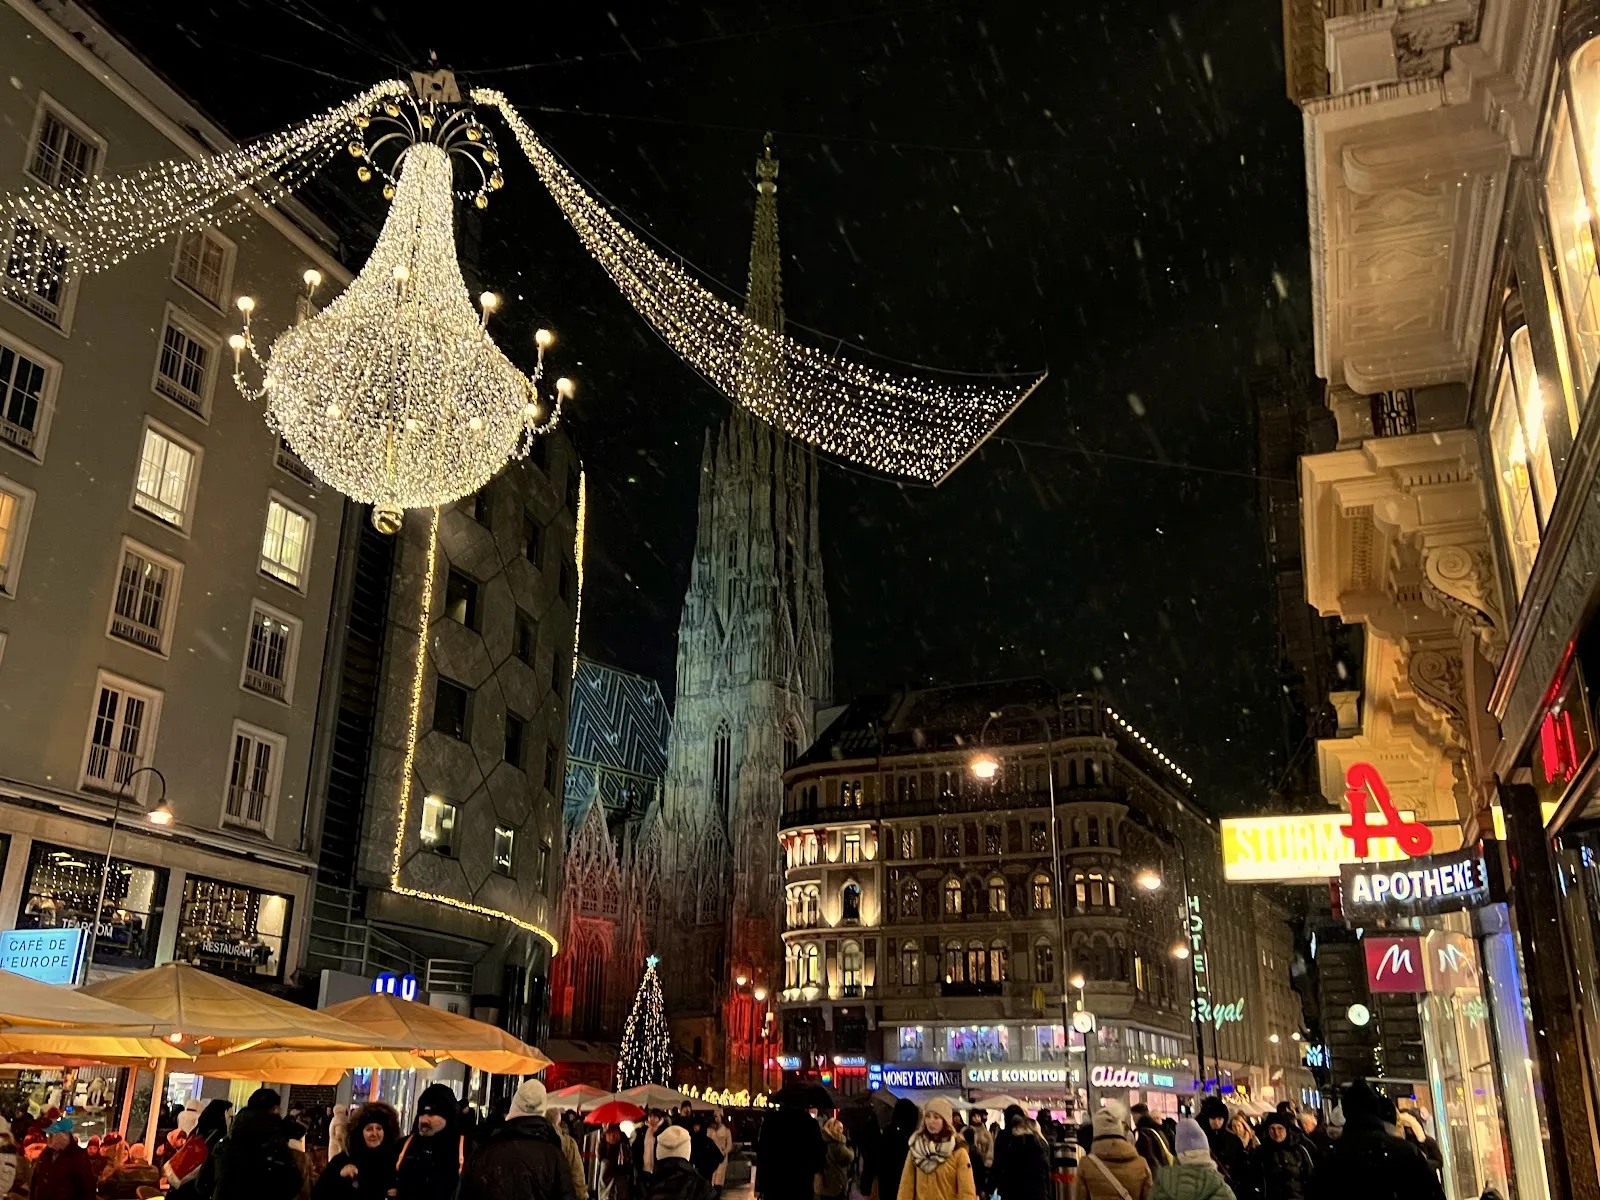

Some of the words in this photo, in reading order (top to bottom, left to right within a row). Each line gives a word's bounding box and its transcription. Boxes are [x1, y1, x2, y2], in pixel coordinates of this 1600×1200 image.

[1352, 860, 1474, 903] APOTHEKE
[10, 937, 43, 951] CAFÉ
[49, 939, 66, 950] DE
[202, 940, 255, 958] RESTAURANT
[1188, 895, 1206, 992] HOTEL
[0, 955, 69, 968] L'EUROPE
[1191, 997, 1244, 1030] Royal
[883, 1071, 914, 1087] MONEY
